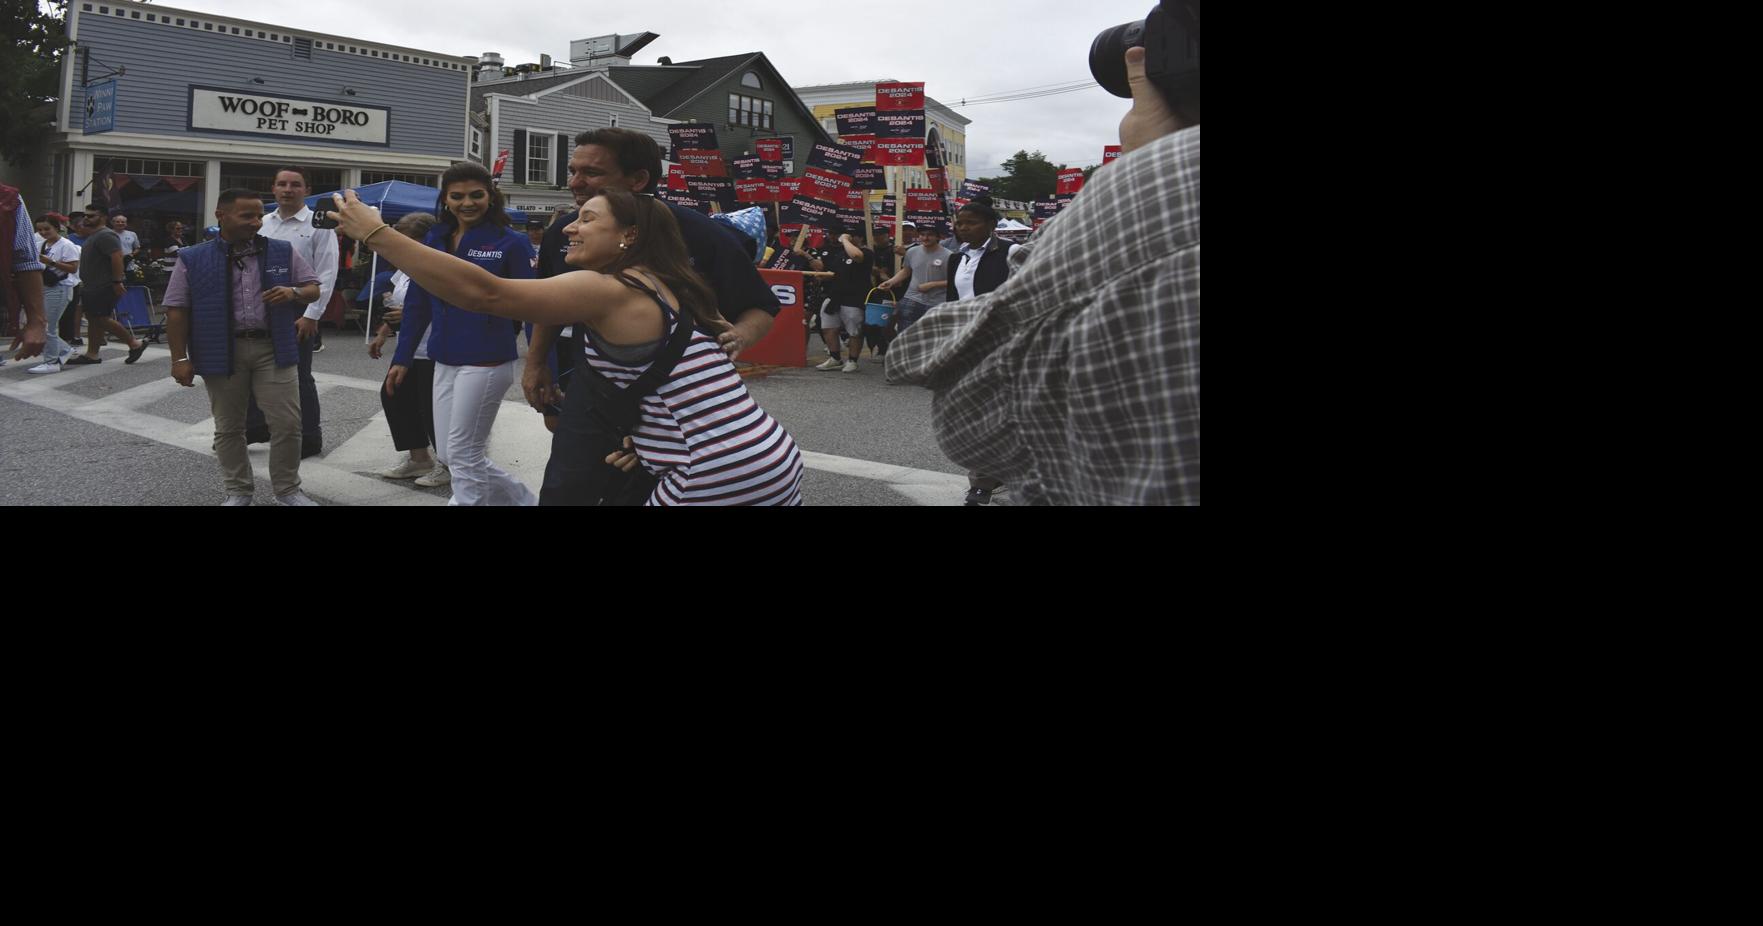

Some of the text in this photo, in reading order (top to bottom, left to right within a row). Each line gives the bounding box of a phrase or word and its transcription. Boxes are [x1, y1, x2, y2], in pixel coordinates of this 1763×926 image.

[877, 86, 924, 94] DESANTIS
[218, 96, 369, 127] WOOF BORO
[836, 111, 876, 120] DESANTIS
[256, 118, 336, 135] PET SHOP
[816, 144, 861, 160] DESANTIS
[824, 152, 848, 161] 2024
[805, 172, 851, 187] DESANTIS
[792, 198, 836, 214] DESANTIS
[801, 206, 824, 216] 2024
[468, 248, 503, 259] DESANTIS
